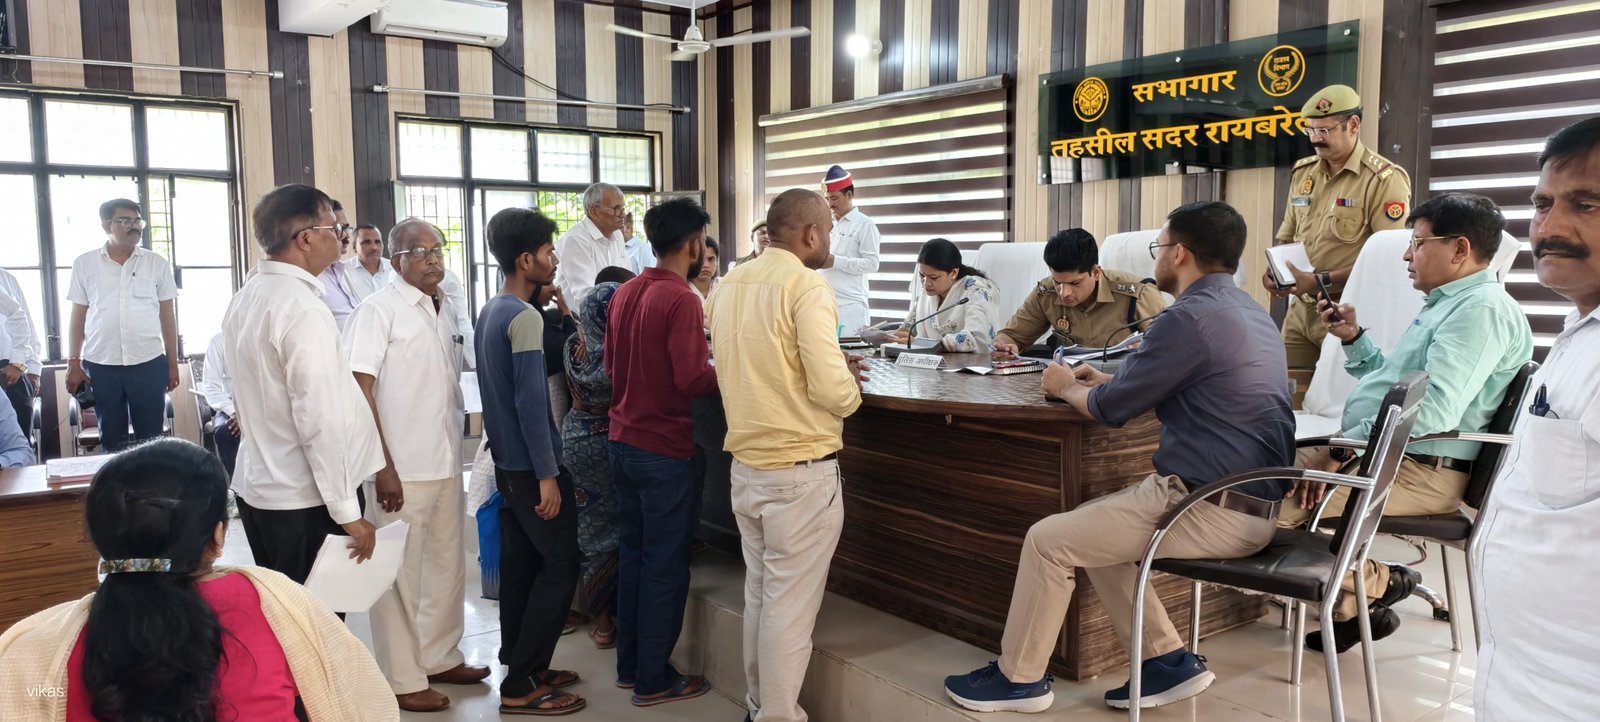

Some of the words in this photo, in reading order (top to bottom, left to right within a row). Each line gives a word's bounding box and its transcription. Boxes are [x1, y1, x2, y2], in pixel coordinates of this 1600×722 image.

[1132, 70, 1237, 103] सभागार
[1051, 127, 1137, 159] तहसील
[1141, 124, 1200, 150] सदर
